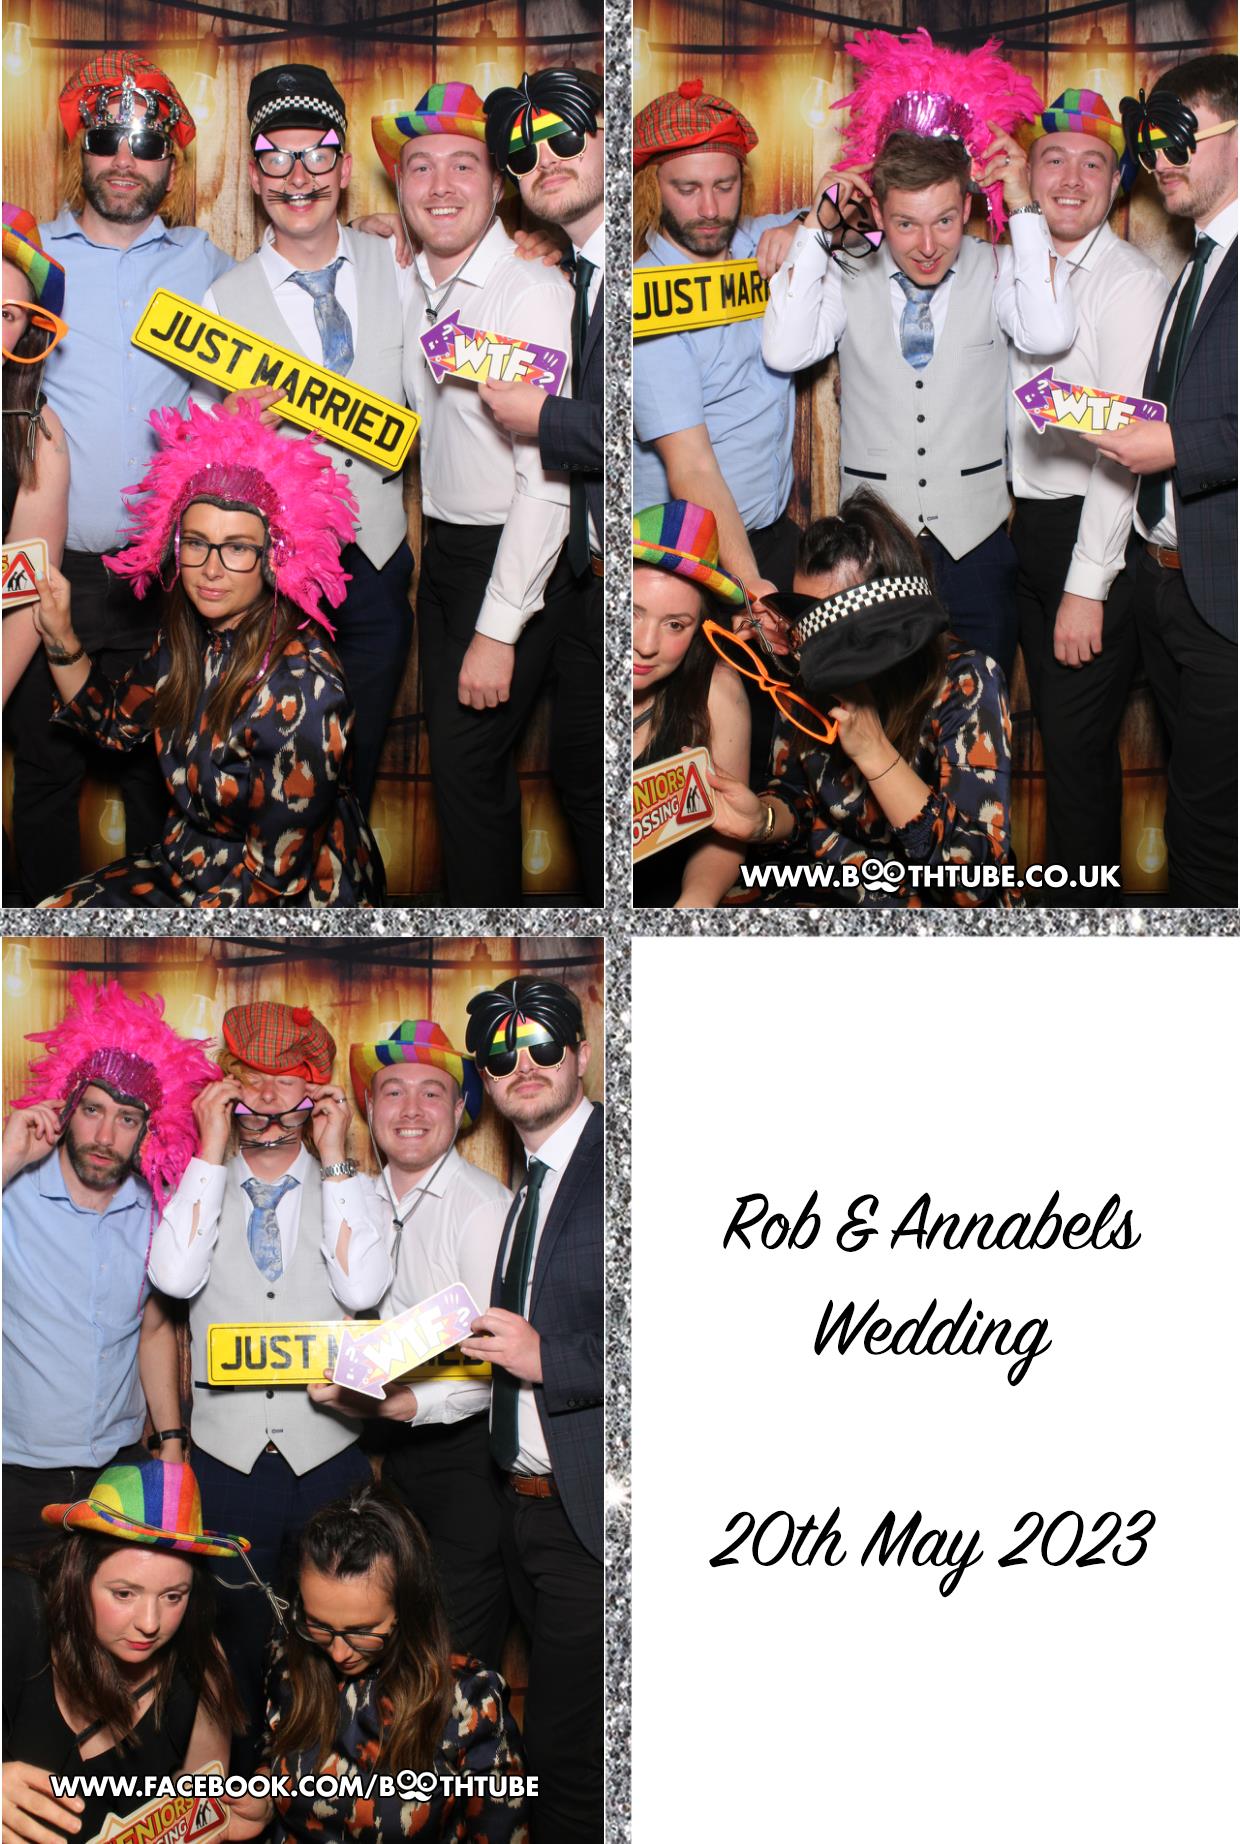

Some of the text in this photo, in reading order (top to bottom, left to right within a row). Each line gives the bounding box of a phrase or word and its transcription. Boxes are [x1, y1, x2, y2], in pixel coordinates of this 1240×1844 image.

[633, 276, 711, 320] JUST
[454, 334, 537, 382] WTF
[150, 310, 405, 453] JUST MARRIED
[1051, 389, 1136, 431] WTF
[220, 1335, 316, 1370] JUST
[363, 1306, 445, 1375] WTF
